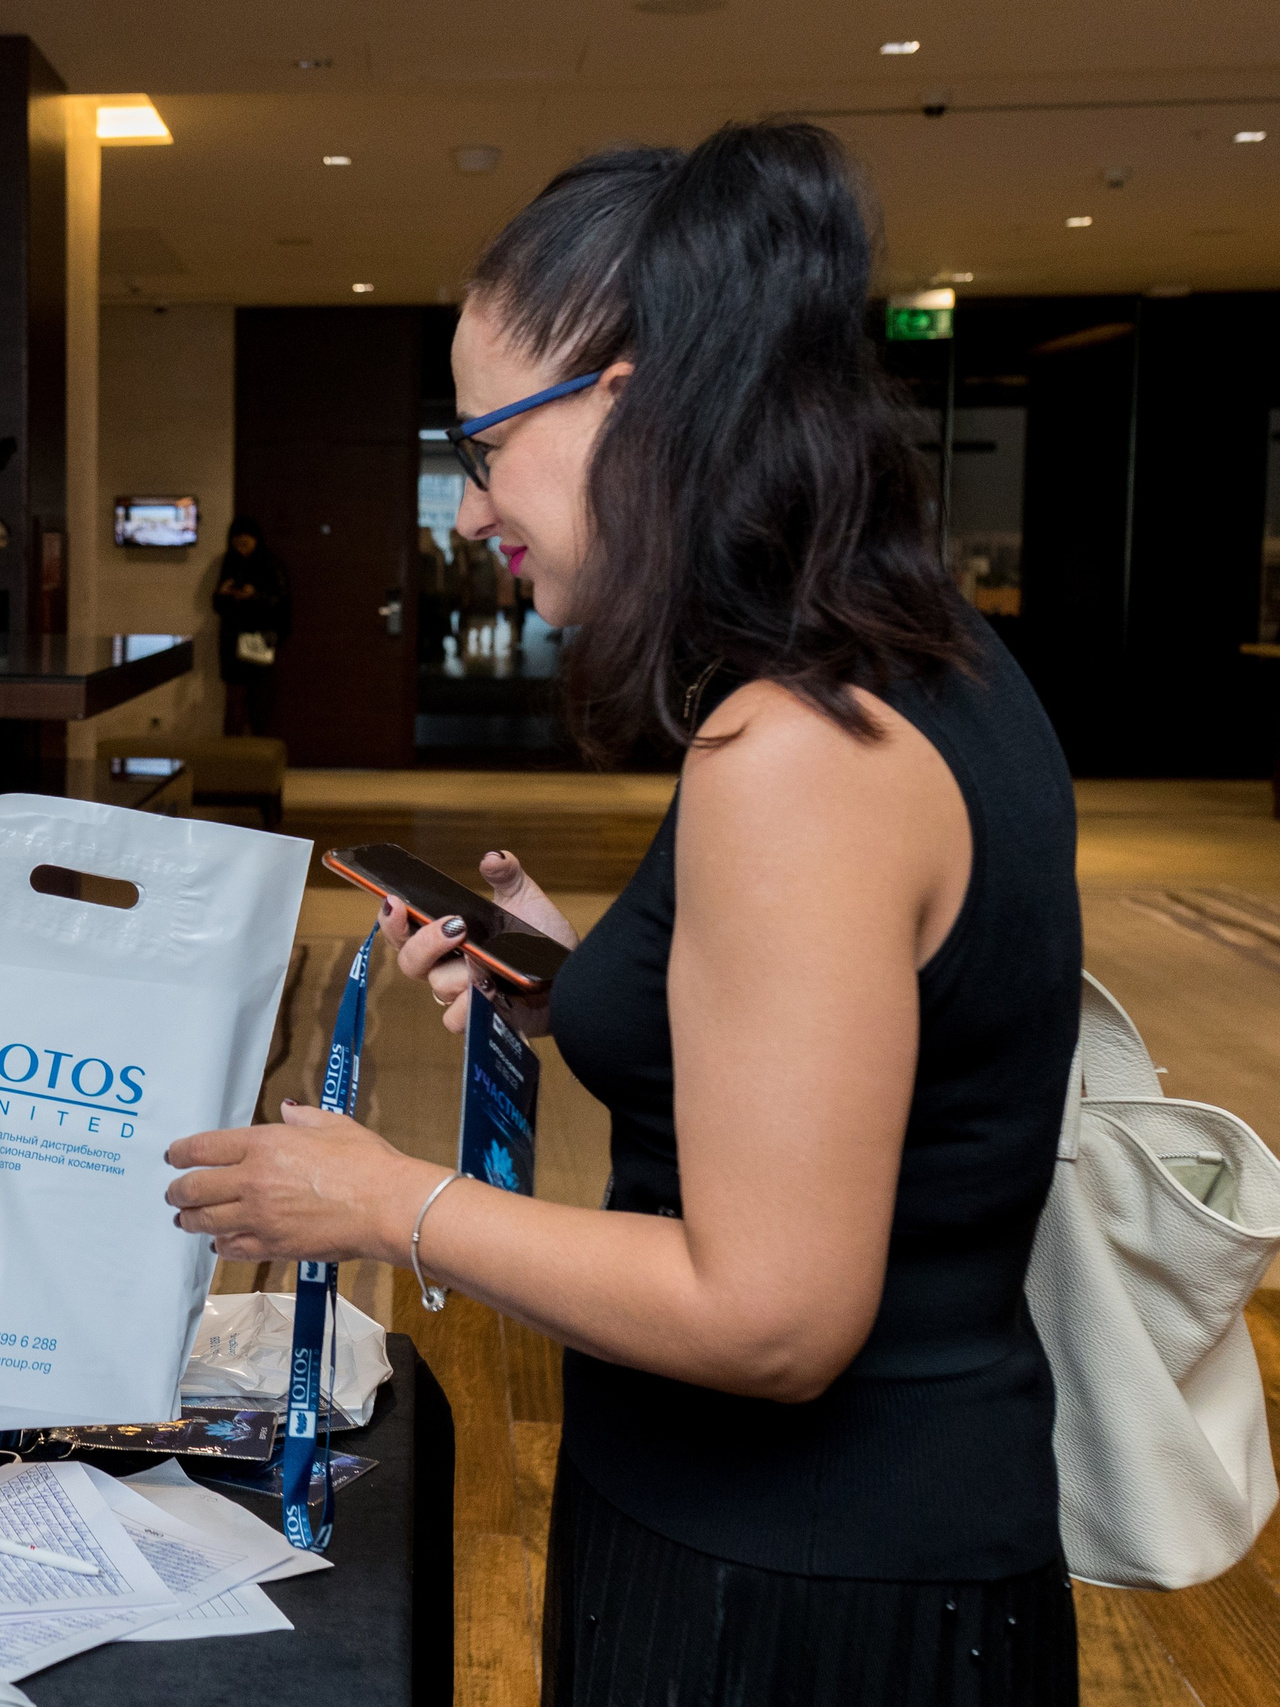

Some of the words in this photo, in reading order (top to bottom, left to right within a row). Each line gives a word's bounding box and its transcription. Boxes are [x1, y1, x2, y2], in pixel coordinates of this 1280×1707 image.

[322, 1042, 343, 1105] LOTOS
[40, 1138, 121, 1162] дистрибьютор
[67, 1157, 126, 1176] косметики
[20, 1335, 30, 1348] 6
[32, 1336, 58, 1352] 288
[291, 1347, 312, 1409] LOTOS
